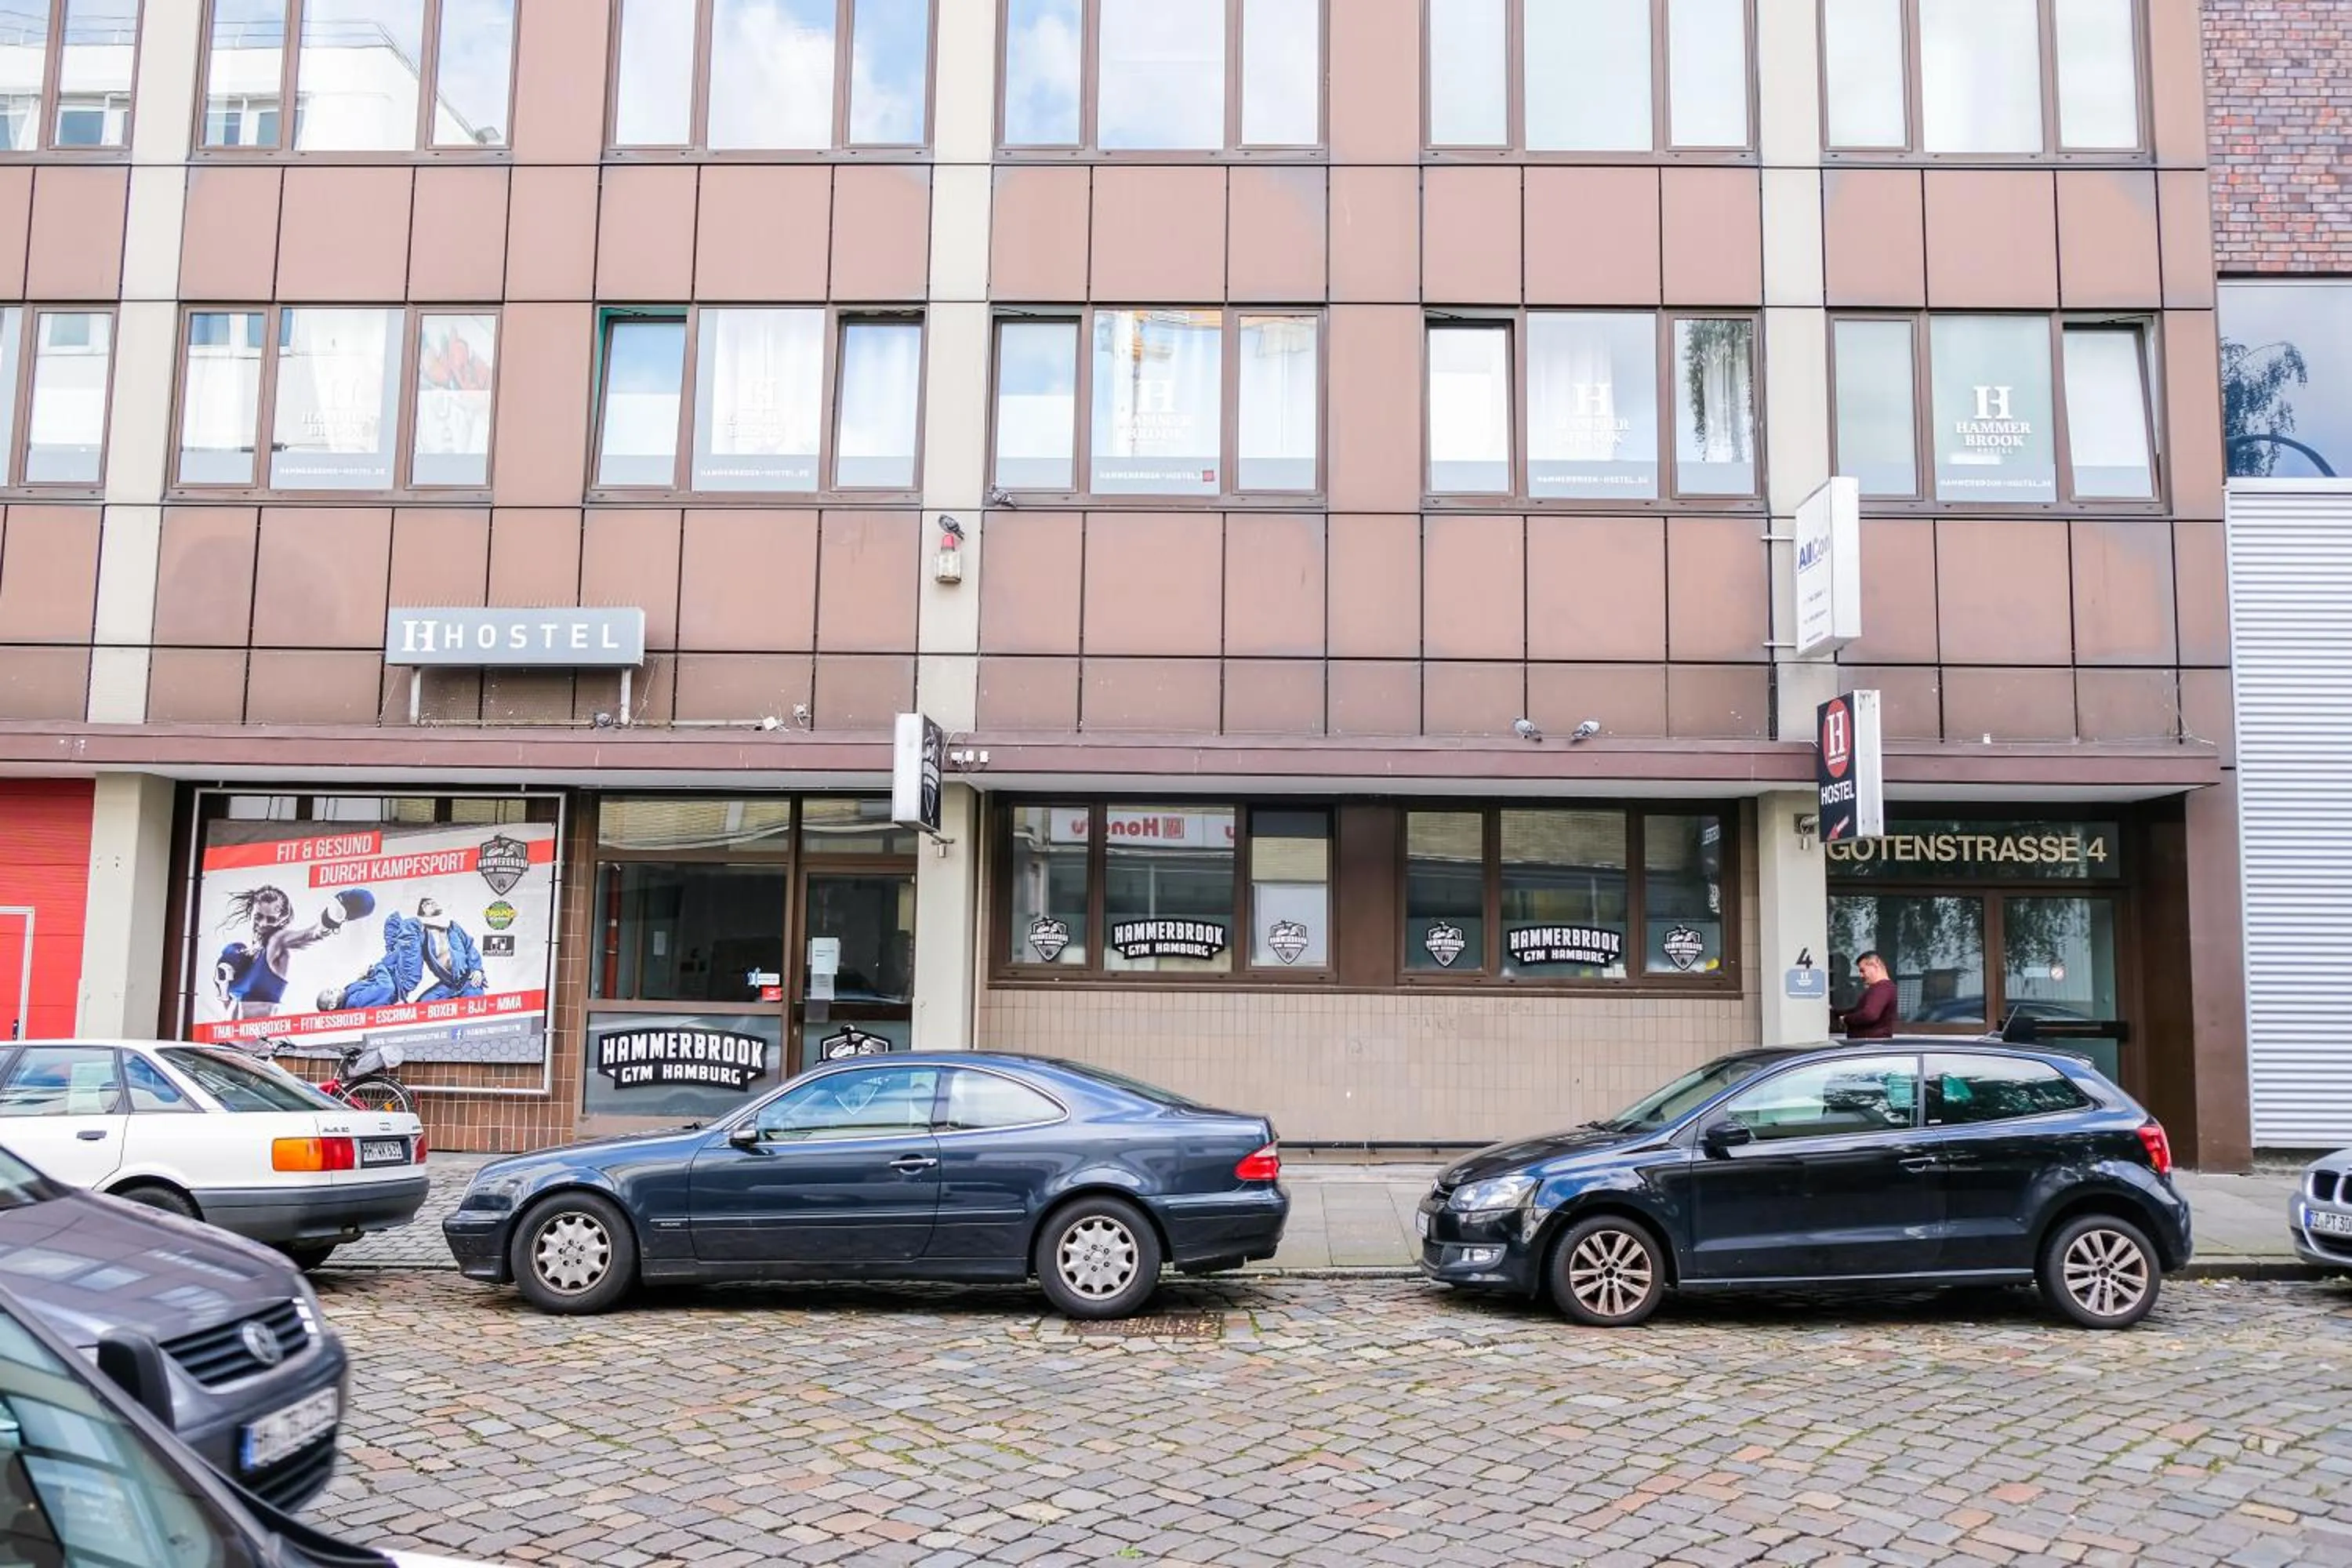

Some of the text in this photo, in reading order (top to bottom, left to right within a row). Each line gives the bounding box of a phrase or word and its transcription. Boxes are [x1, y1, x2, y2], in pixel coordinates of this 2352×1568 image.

[1973, 386, 2013, 419] H
[1955, 422, 2031, 434] HAMMER
[1965, 434, 2024, 446] BROOK
[445, 623, 620, 649] HOSTEL
[1827, 710, 1846, 757] H
[1820, 779, 1856, 805] HOSTEL
[276, 835, 372, 862] FIT & GESUND
[1826, 834, 2107, 863] GOTENSTRASSE 4
[319, 851, 468, 885] DURCH KAMPFSPORT
[1114, 920, 1225, 946] HAMMERBROOK
[1510, 928, 1620, 953] HAMMERBROOK
[1128, 942, 1209, 956] GYM HAMBURG
[1523, 949, 1605, 963] GYM HAMBURG
[1795, 946, 1813, 969] 4
[300, 1012, 366, 1031] FITNESSBOXEN
[376, 1007, 417, 1023] ESCRIMA
[427, 1003, 458, 1018] BOXEN
[468, 998, 487, 1014] BJJ
[496, 996, 522, 1011] MMA
[602, 1031, 764, 1069] HAMMERBROOK
[621, 1064, 742, 1085] GYM HAMBURG
